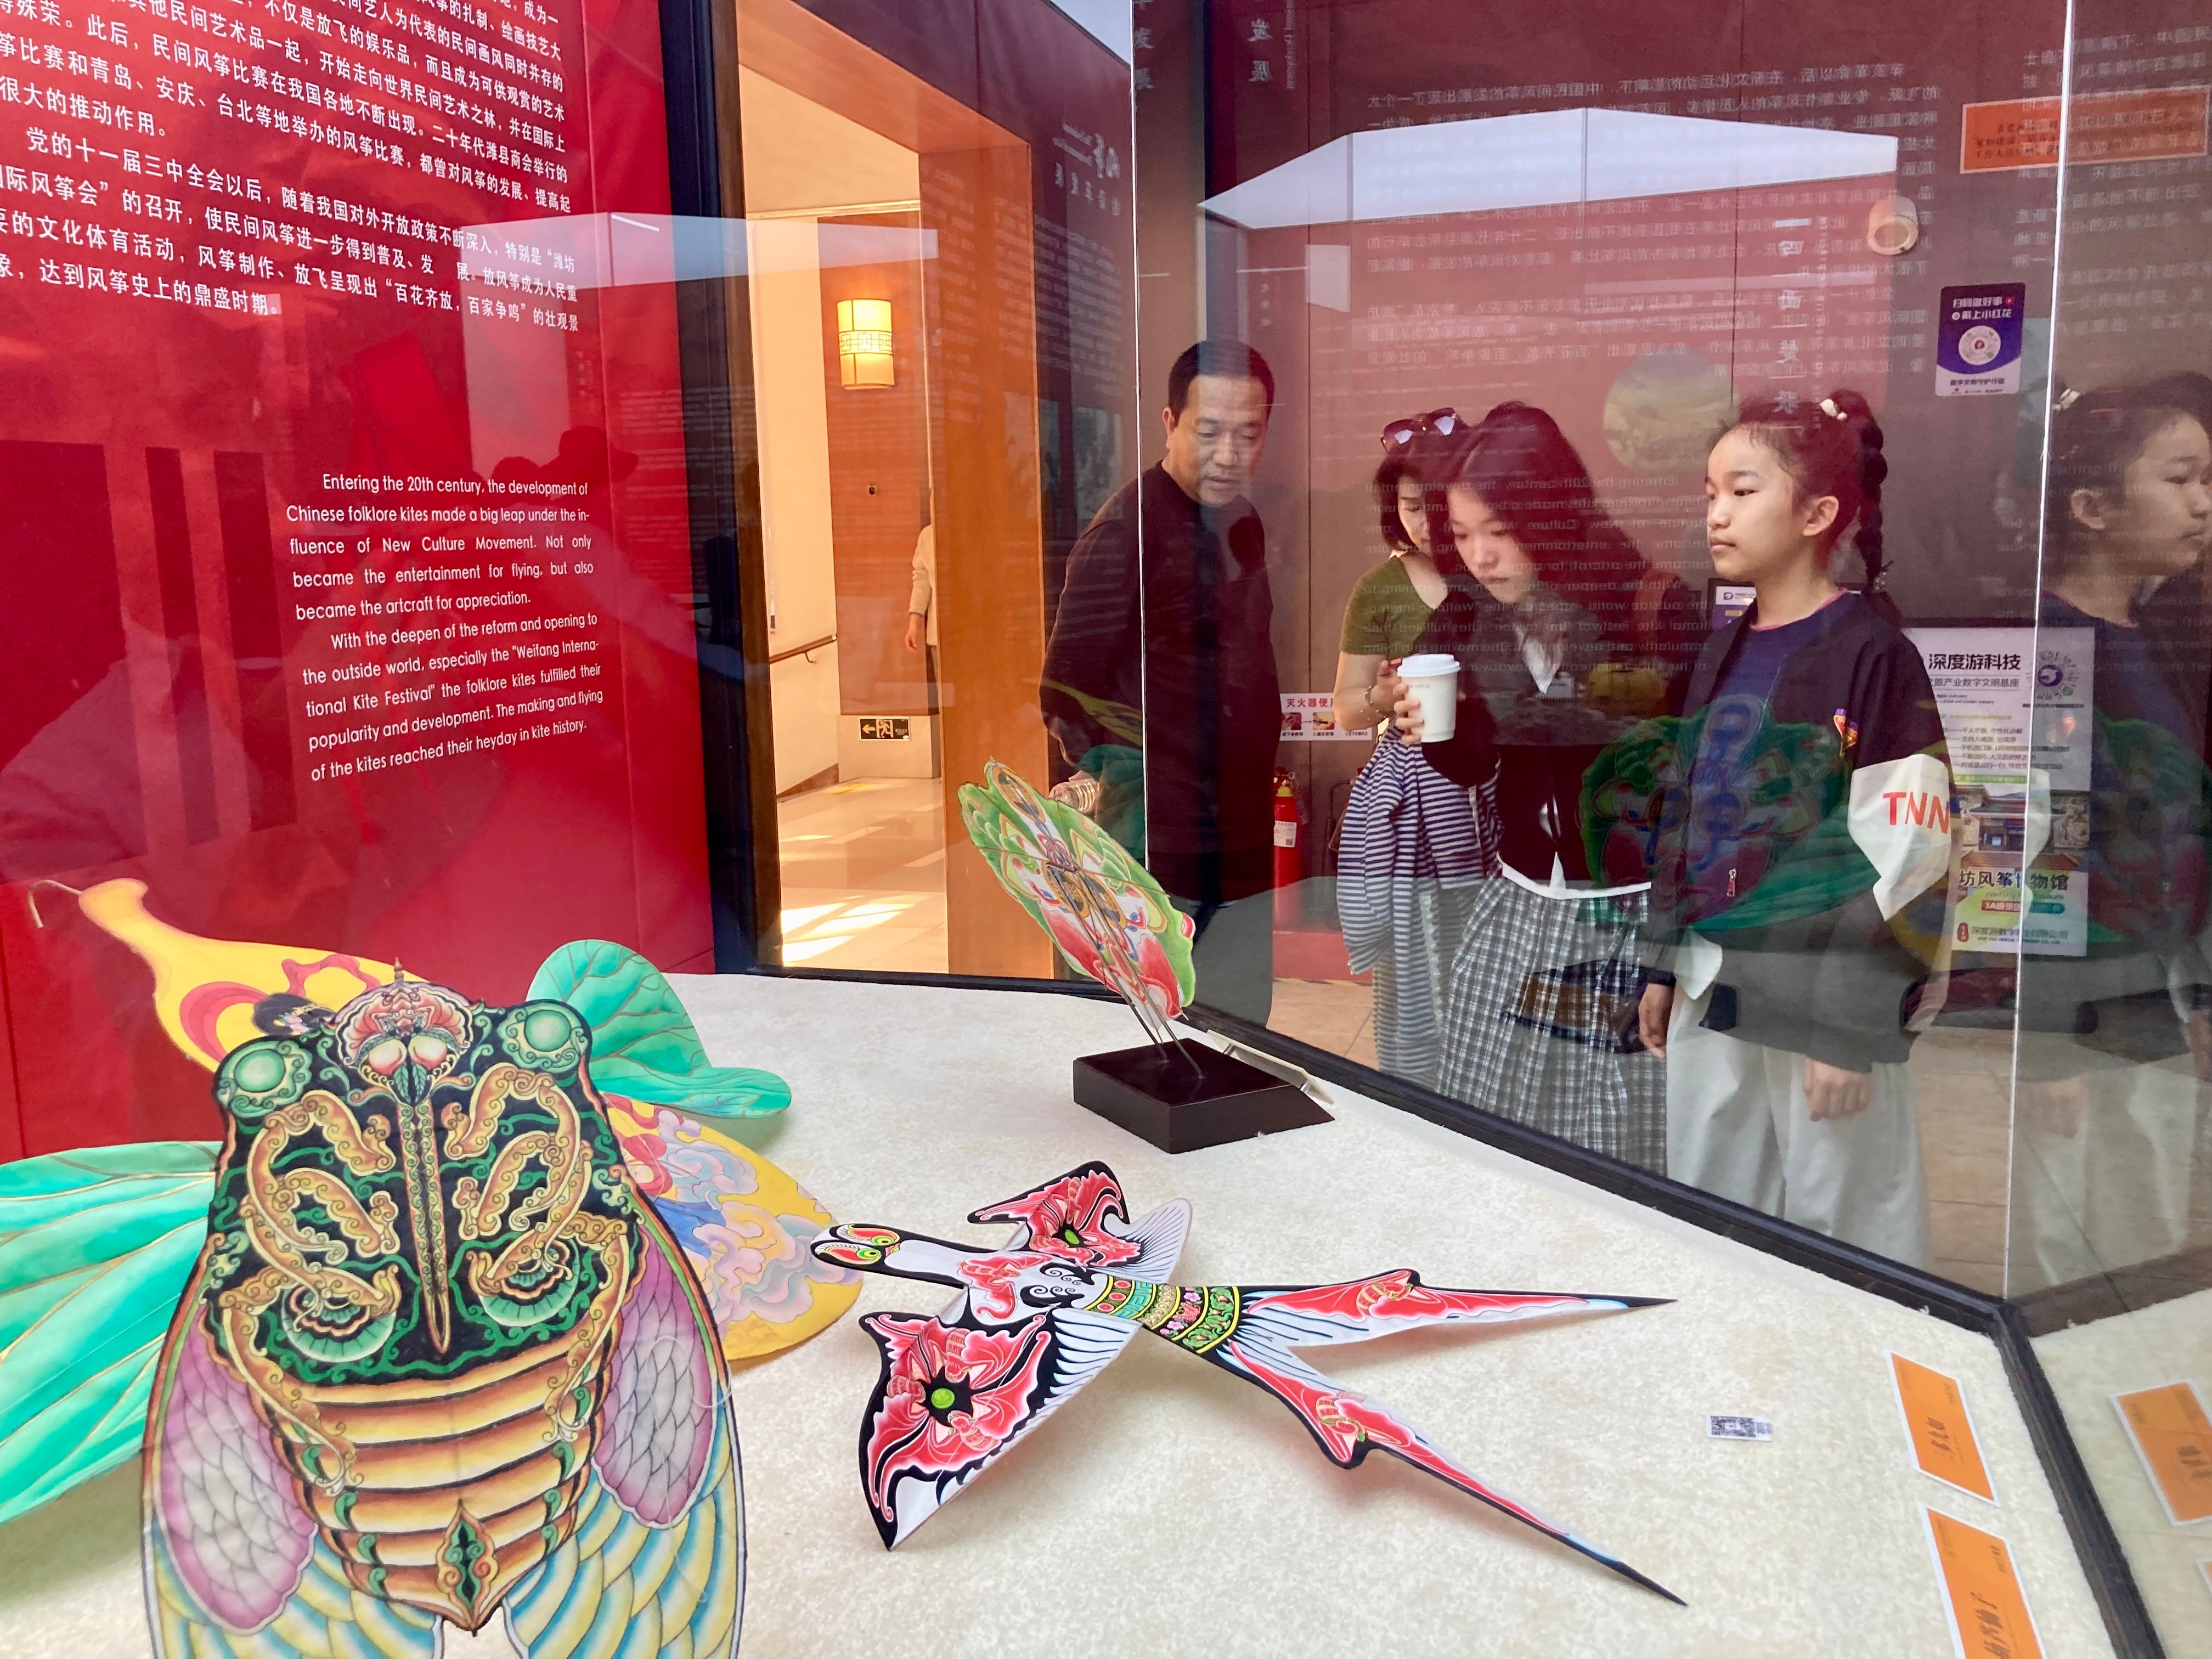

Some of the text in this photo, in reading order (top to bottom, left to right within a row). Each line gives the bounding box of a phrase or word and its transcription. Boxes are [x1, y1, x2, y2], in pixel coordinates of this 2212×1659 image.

[323, 473, 588, 497] Entering the 20th century, the development of
[286, 505, 590, 524] Chinese folklore kites made a big leap under the in-
[289, 534, 592, 555] fluence of New Culture Movement. Not only
[292, 560, 594, 588] became the entertainment for flying, but also
[295, 591, 531, 620] became the artcraft for appreciation.
[330, 612, 597, 650] With the deepen of the reform and opening to
[302, 640, 599, 685] the outside world, especially the "Weifang Interna-
[1928, 653, 2022, 671] 深度游科技
[306, 663, 601, 718] tional Kite Festival" the folklore kites fulfilled their
[308, 690, 603, 753] popularity and development. The making and flying
[311, 719, 587, 781] of the kites reached their heyday in kite history.
